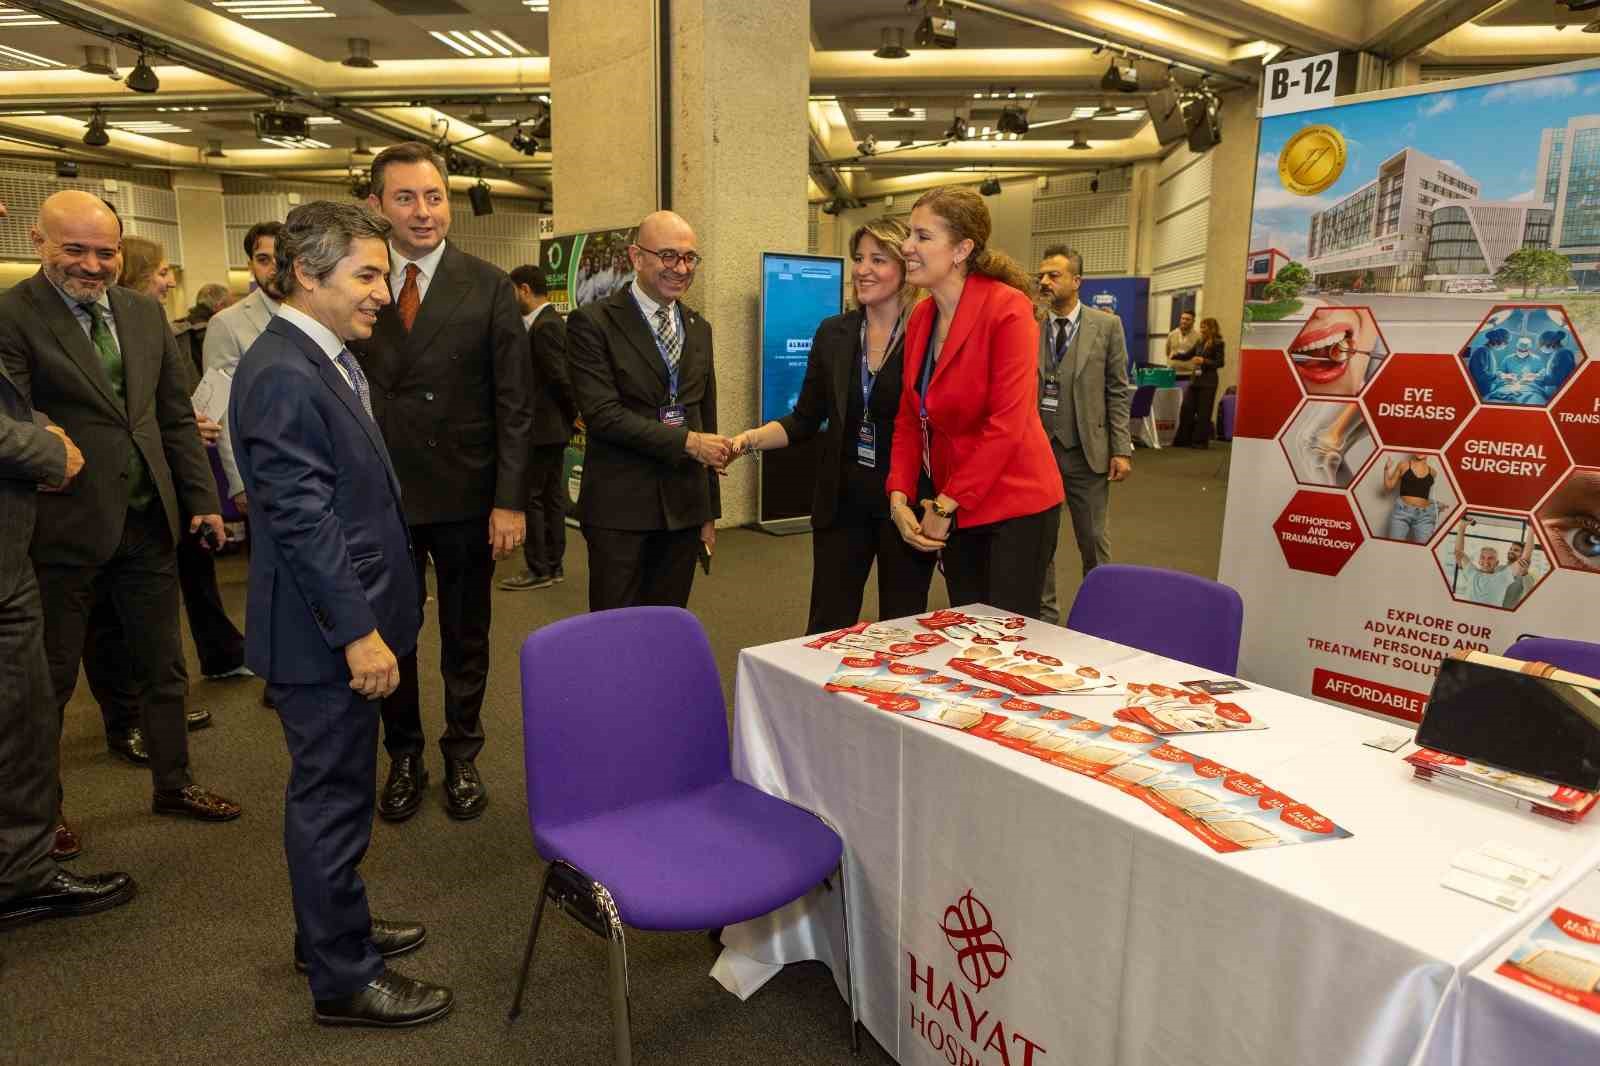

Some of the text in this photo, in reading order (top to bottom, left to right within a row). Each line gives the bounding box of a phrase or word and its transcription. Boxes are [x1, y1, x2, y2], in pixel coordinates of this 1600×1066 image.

[1271, 59, 1333, 100] B-12
[1403, 387, 1433, 402] EYE
[1378, 403, 1456, 421] DISEASES
[1464, 439, 1548, 460] GENERAL
[1460, 456, 1548, 478] SURGERY
[1288, 514, 1352, 531] ORTHOPEDICS
[1307, 526, 1329, 537] AND
[1281, 531, 1357, 551] TRAUMATOLOGY
[1387, 608, 1492, 640] EXPLORE OUR
[1364, 620, 1489, 654] ADVANCED AND
[1307, 637, 1390, 666] TREATMENT
[1324, 678, 1419, 713] AFFORDABLE
[907, 951, 1047, 1066] HAYAT
[909, 1000, 980, 1066] HOSP
